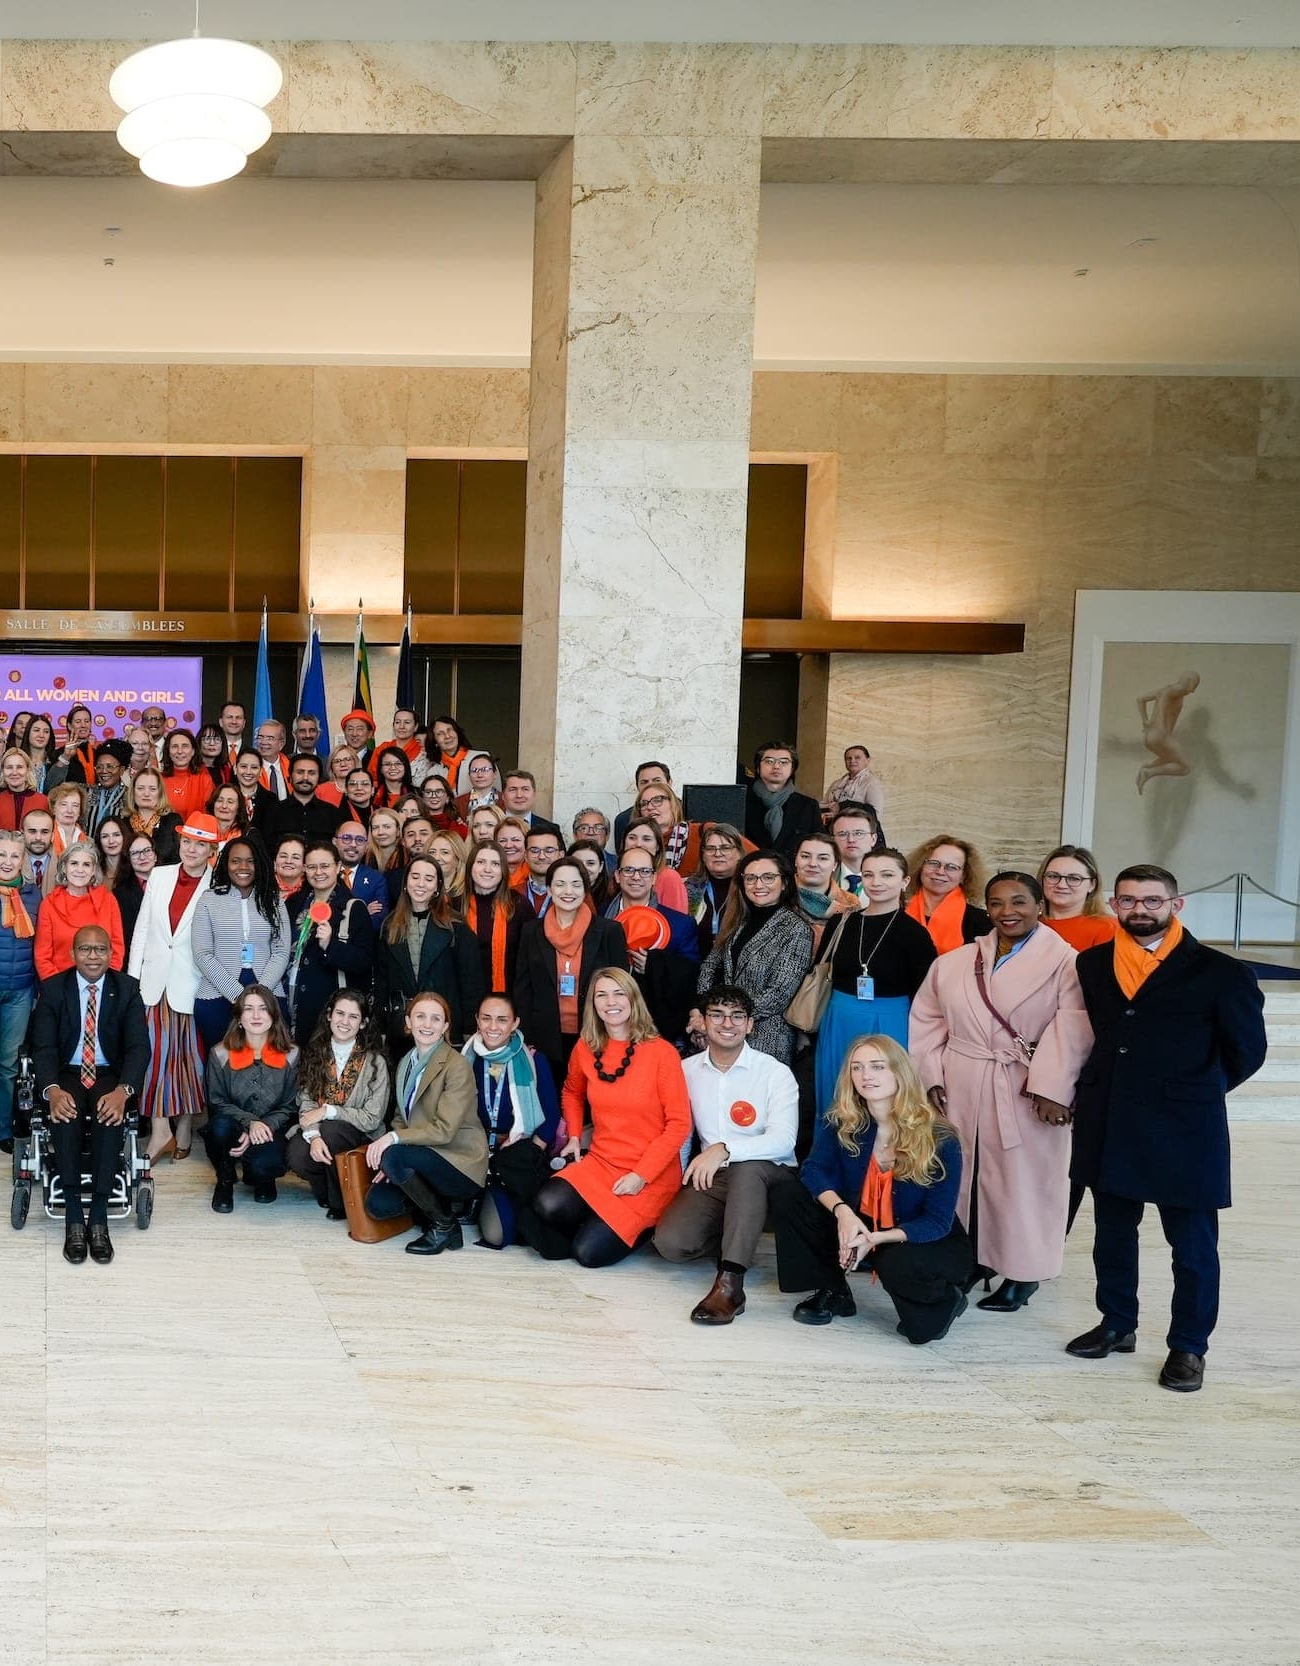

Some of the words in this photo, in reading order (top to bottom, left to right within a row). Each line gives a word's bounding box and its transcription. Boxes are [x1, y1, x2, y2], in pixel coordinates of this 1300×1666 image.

[6, 618, 50, 631] SALLE
[3, 689, 33, 702] ALL
[36, 689, 101, 702] WOMEN
[102, 690, 137, 703] AND
[140, 690, 185, 704] GIRLS
